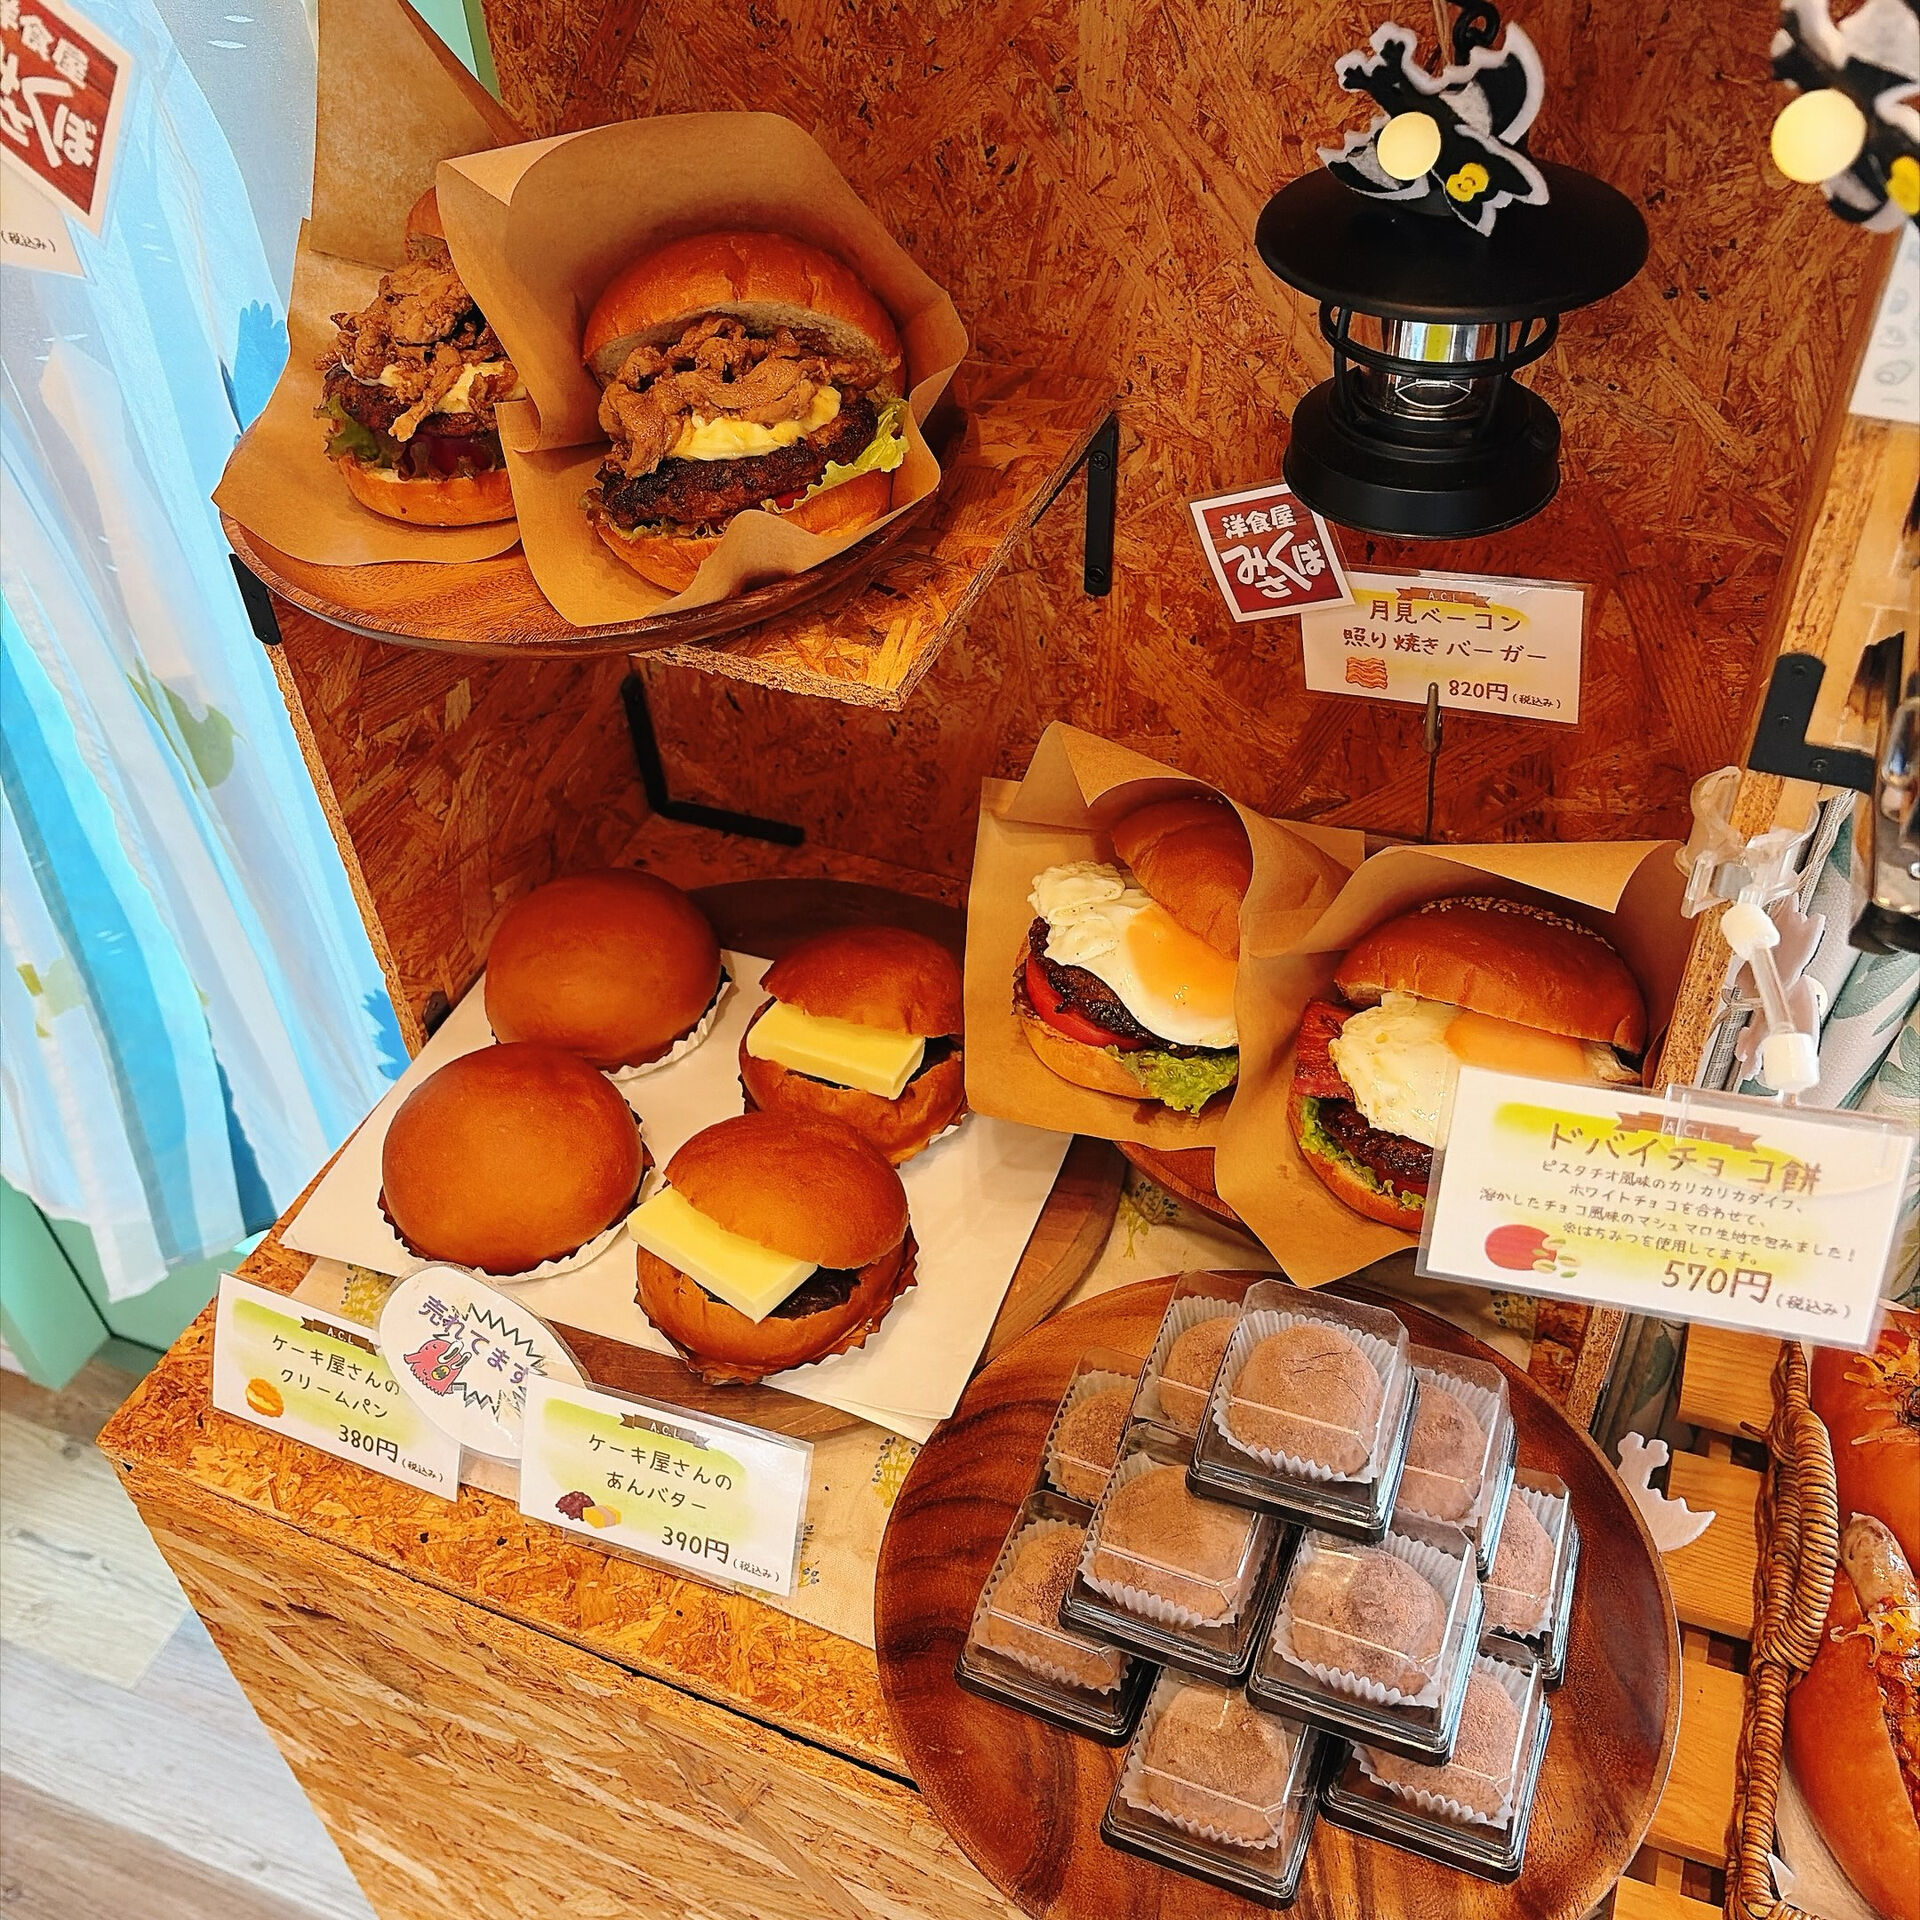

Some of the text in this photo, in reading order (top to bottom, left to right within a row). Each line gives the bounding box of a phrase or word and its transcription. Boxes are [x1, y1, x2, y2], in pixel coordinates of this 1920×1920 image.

[1220, 504, 1297, 540] 洋食屋
[1369, 600, 1522, 633] 月見ベーコン
[1448, 679, 1509, 702] 820円
[1548, 1122, 1823, 1195] ドバイチョコ餅
[1569, 1183, 1766, 1228] ホワイトチョコを合わせて、
[1661, 1260, 1773, 1306] 570円
[418, 1294, 530, 1384] 売れてます
[271, 1333, 400, 1396] ケーキ屋さんの
[280, 1368, 389, 1419] クリームパン
[338, 1424, 400, 1464] 380円
[588, 1433, 733, 1492] ケーキ屋さんの
[606, 1470, 707, 1511] あんバター
[661, 1525, 730, 1565] 390円
